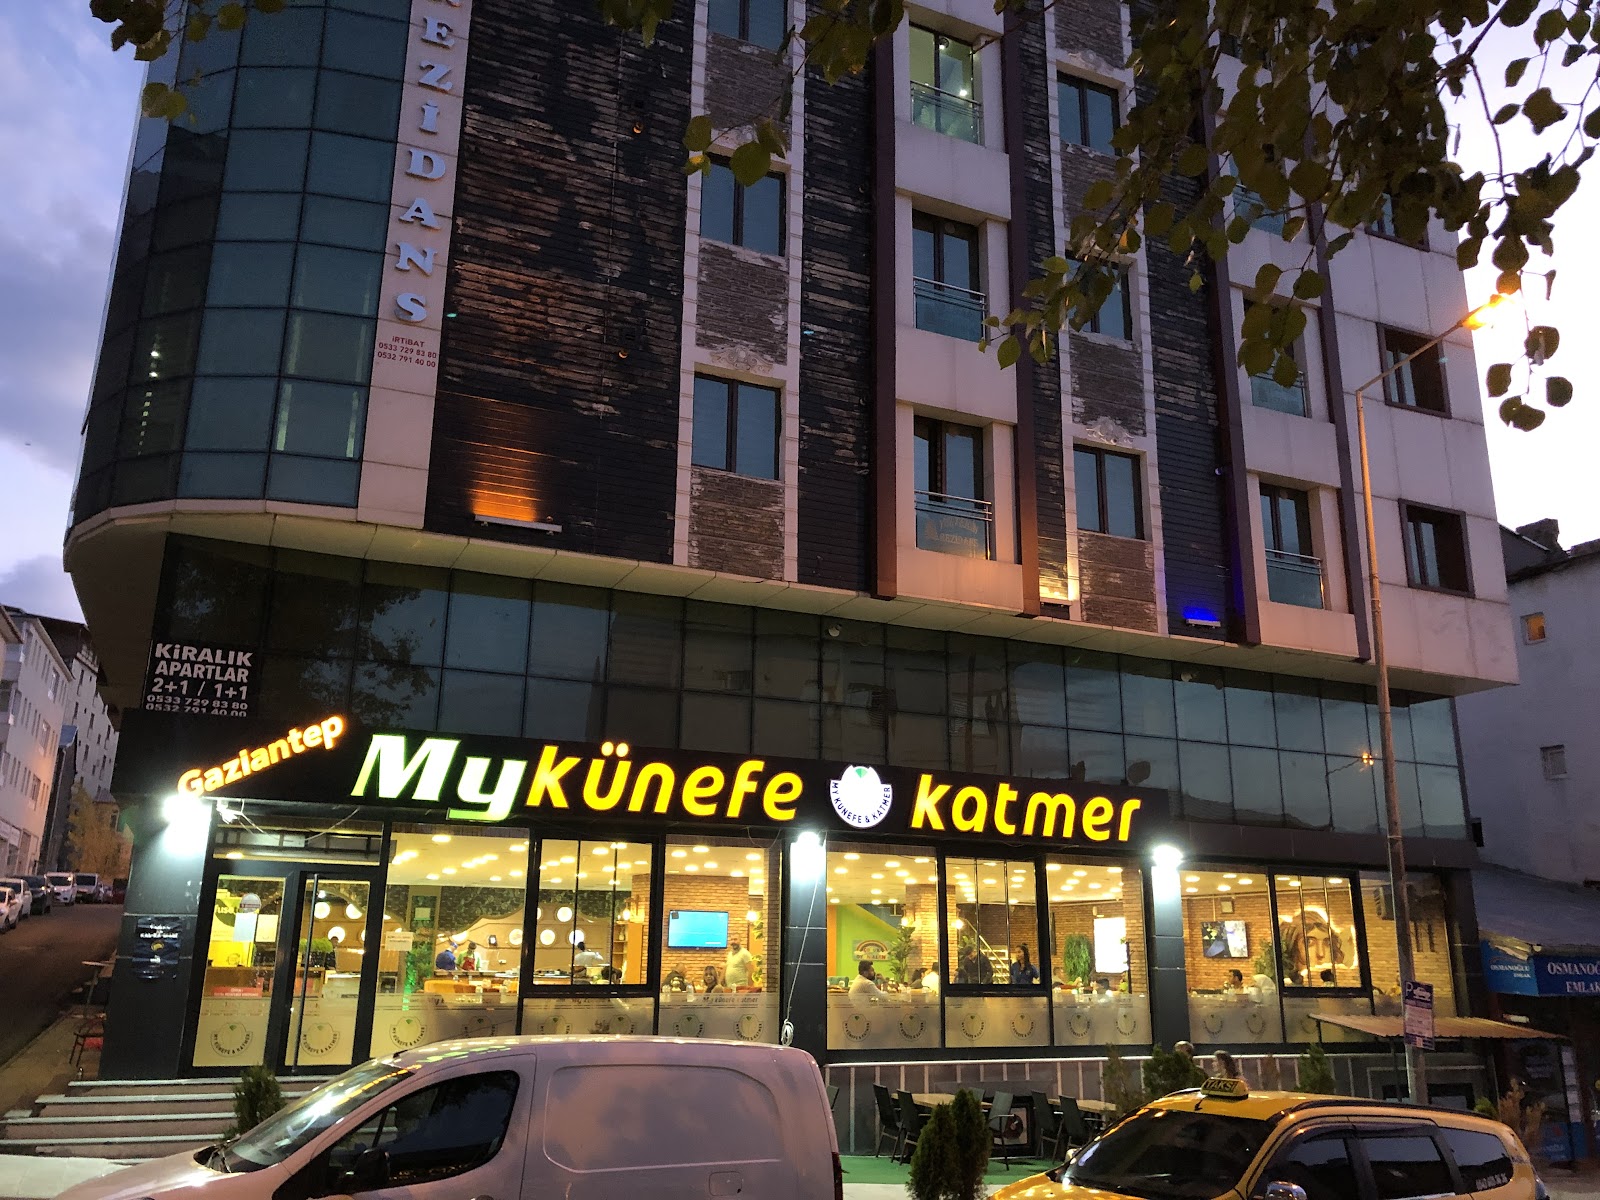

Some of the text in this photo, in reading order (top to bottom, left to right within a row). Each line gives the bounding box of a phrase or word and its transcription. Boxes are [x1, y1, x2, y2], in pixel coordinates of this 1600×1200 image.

[394, 0, 462, 323] EZİDANS
[377, 351, 437, 368] 0532 791 40 00
[378, 342, 437, 359] 0533 729 83 80
[155, 660, 249, 683] APARTLAR
[151, 677, 248, 700] 2+1 / 1+1
[145, 702, 180, 712] 0532
[183, 705, 207, 713] 791
[210, 708, 228, 716] 40
[146, 694, 248, 710] 0533 729 83 80
[177, 714, 344, 799] Gaziantep
[831, 781, 839, 795] MY
[871, 787, 891, 820] KATMER
[911, 773, 1142, 842] katmer
